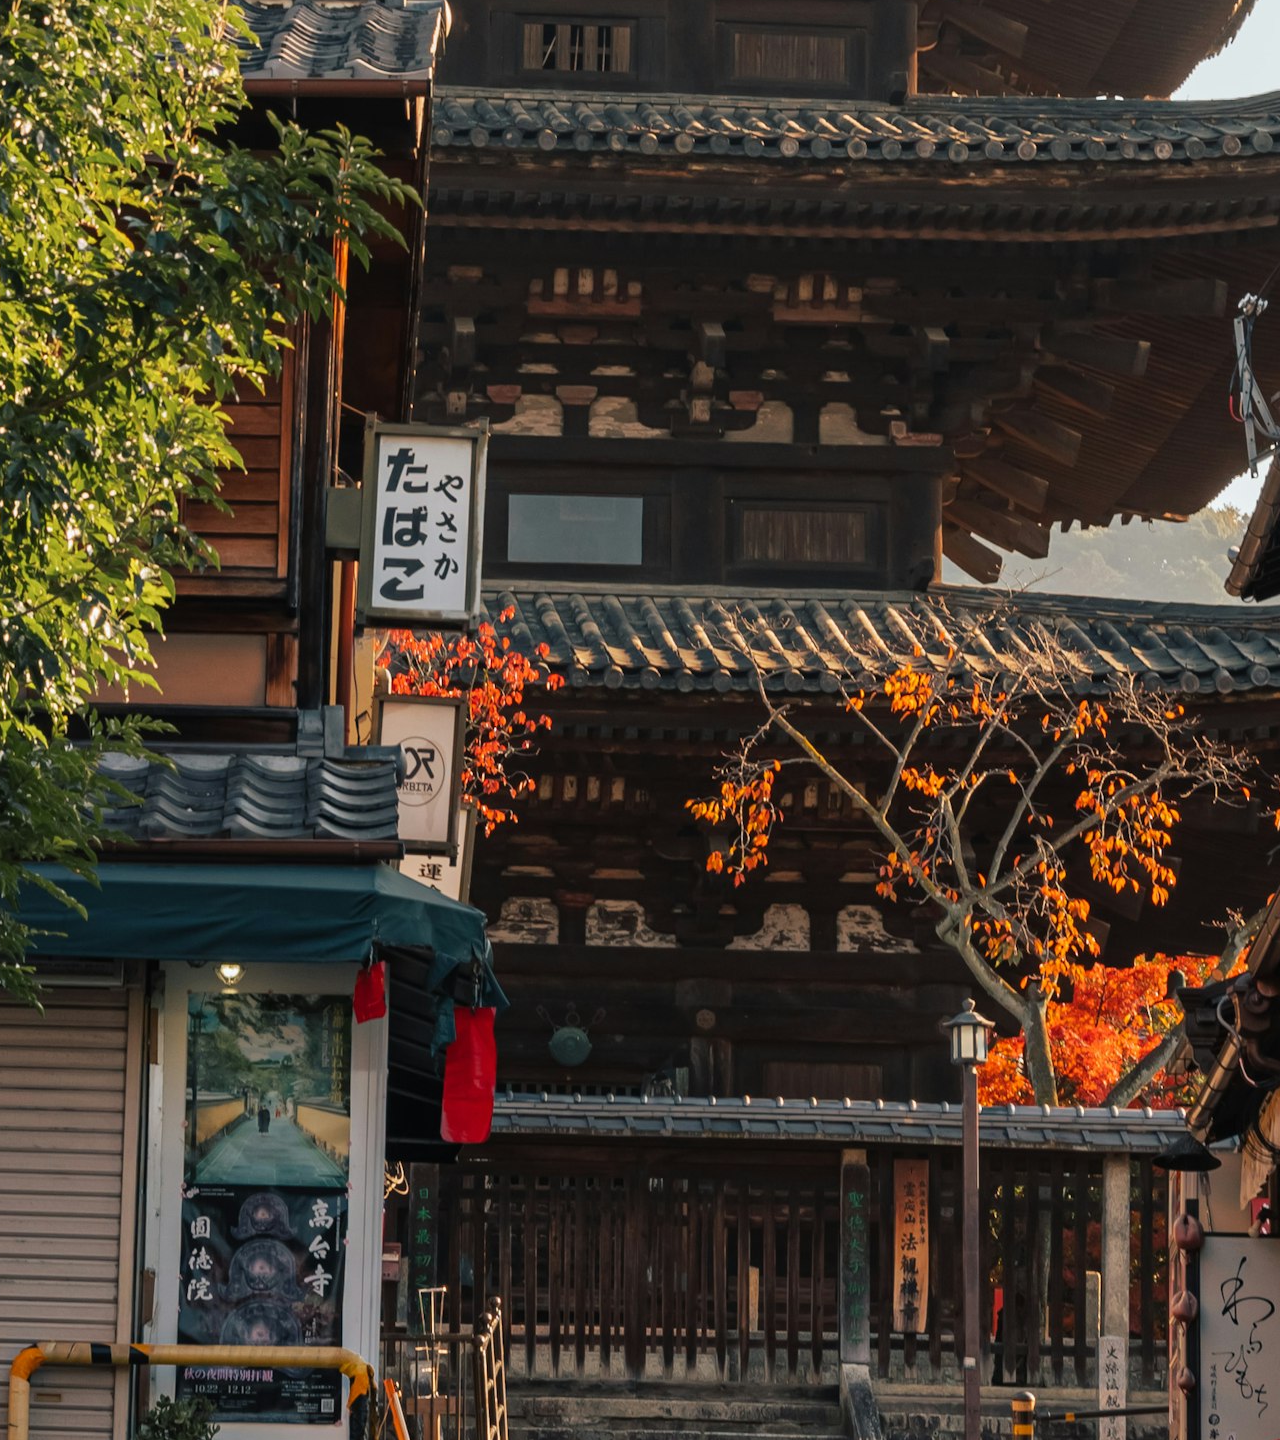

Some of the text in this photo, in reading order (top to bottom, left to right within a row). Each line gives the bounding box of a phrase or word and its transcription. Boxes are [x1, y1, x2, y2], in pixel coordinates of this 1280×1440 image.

[380, 447, 428, 601] たばこ
[433, 474, 464, 580] やさか
[186, 1216, 213, 1301] 圓徳院
[304, 1198, 334, 1297] 高台寺
[183, 1368, 273, 1382] 秋の夜間特別拝観
[1211, 1256, 1275, 1418] わらびもち
[194, 1384, 218, 1394] 10.22
[227, 1385, 251, 1394] 12.12
